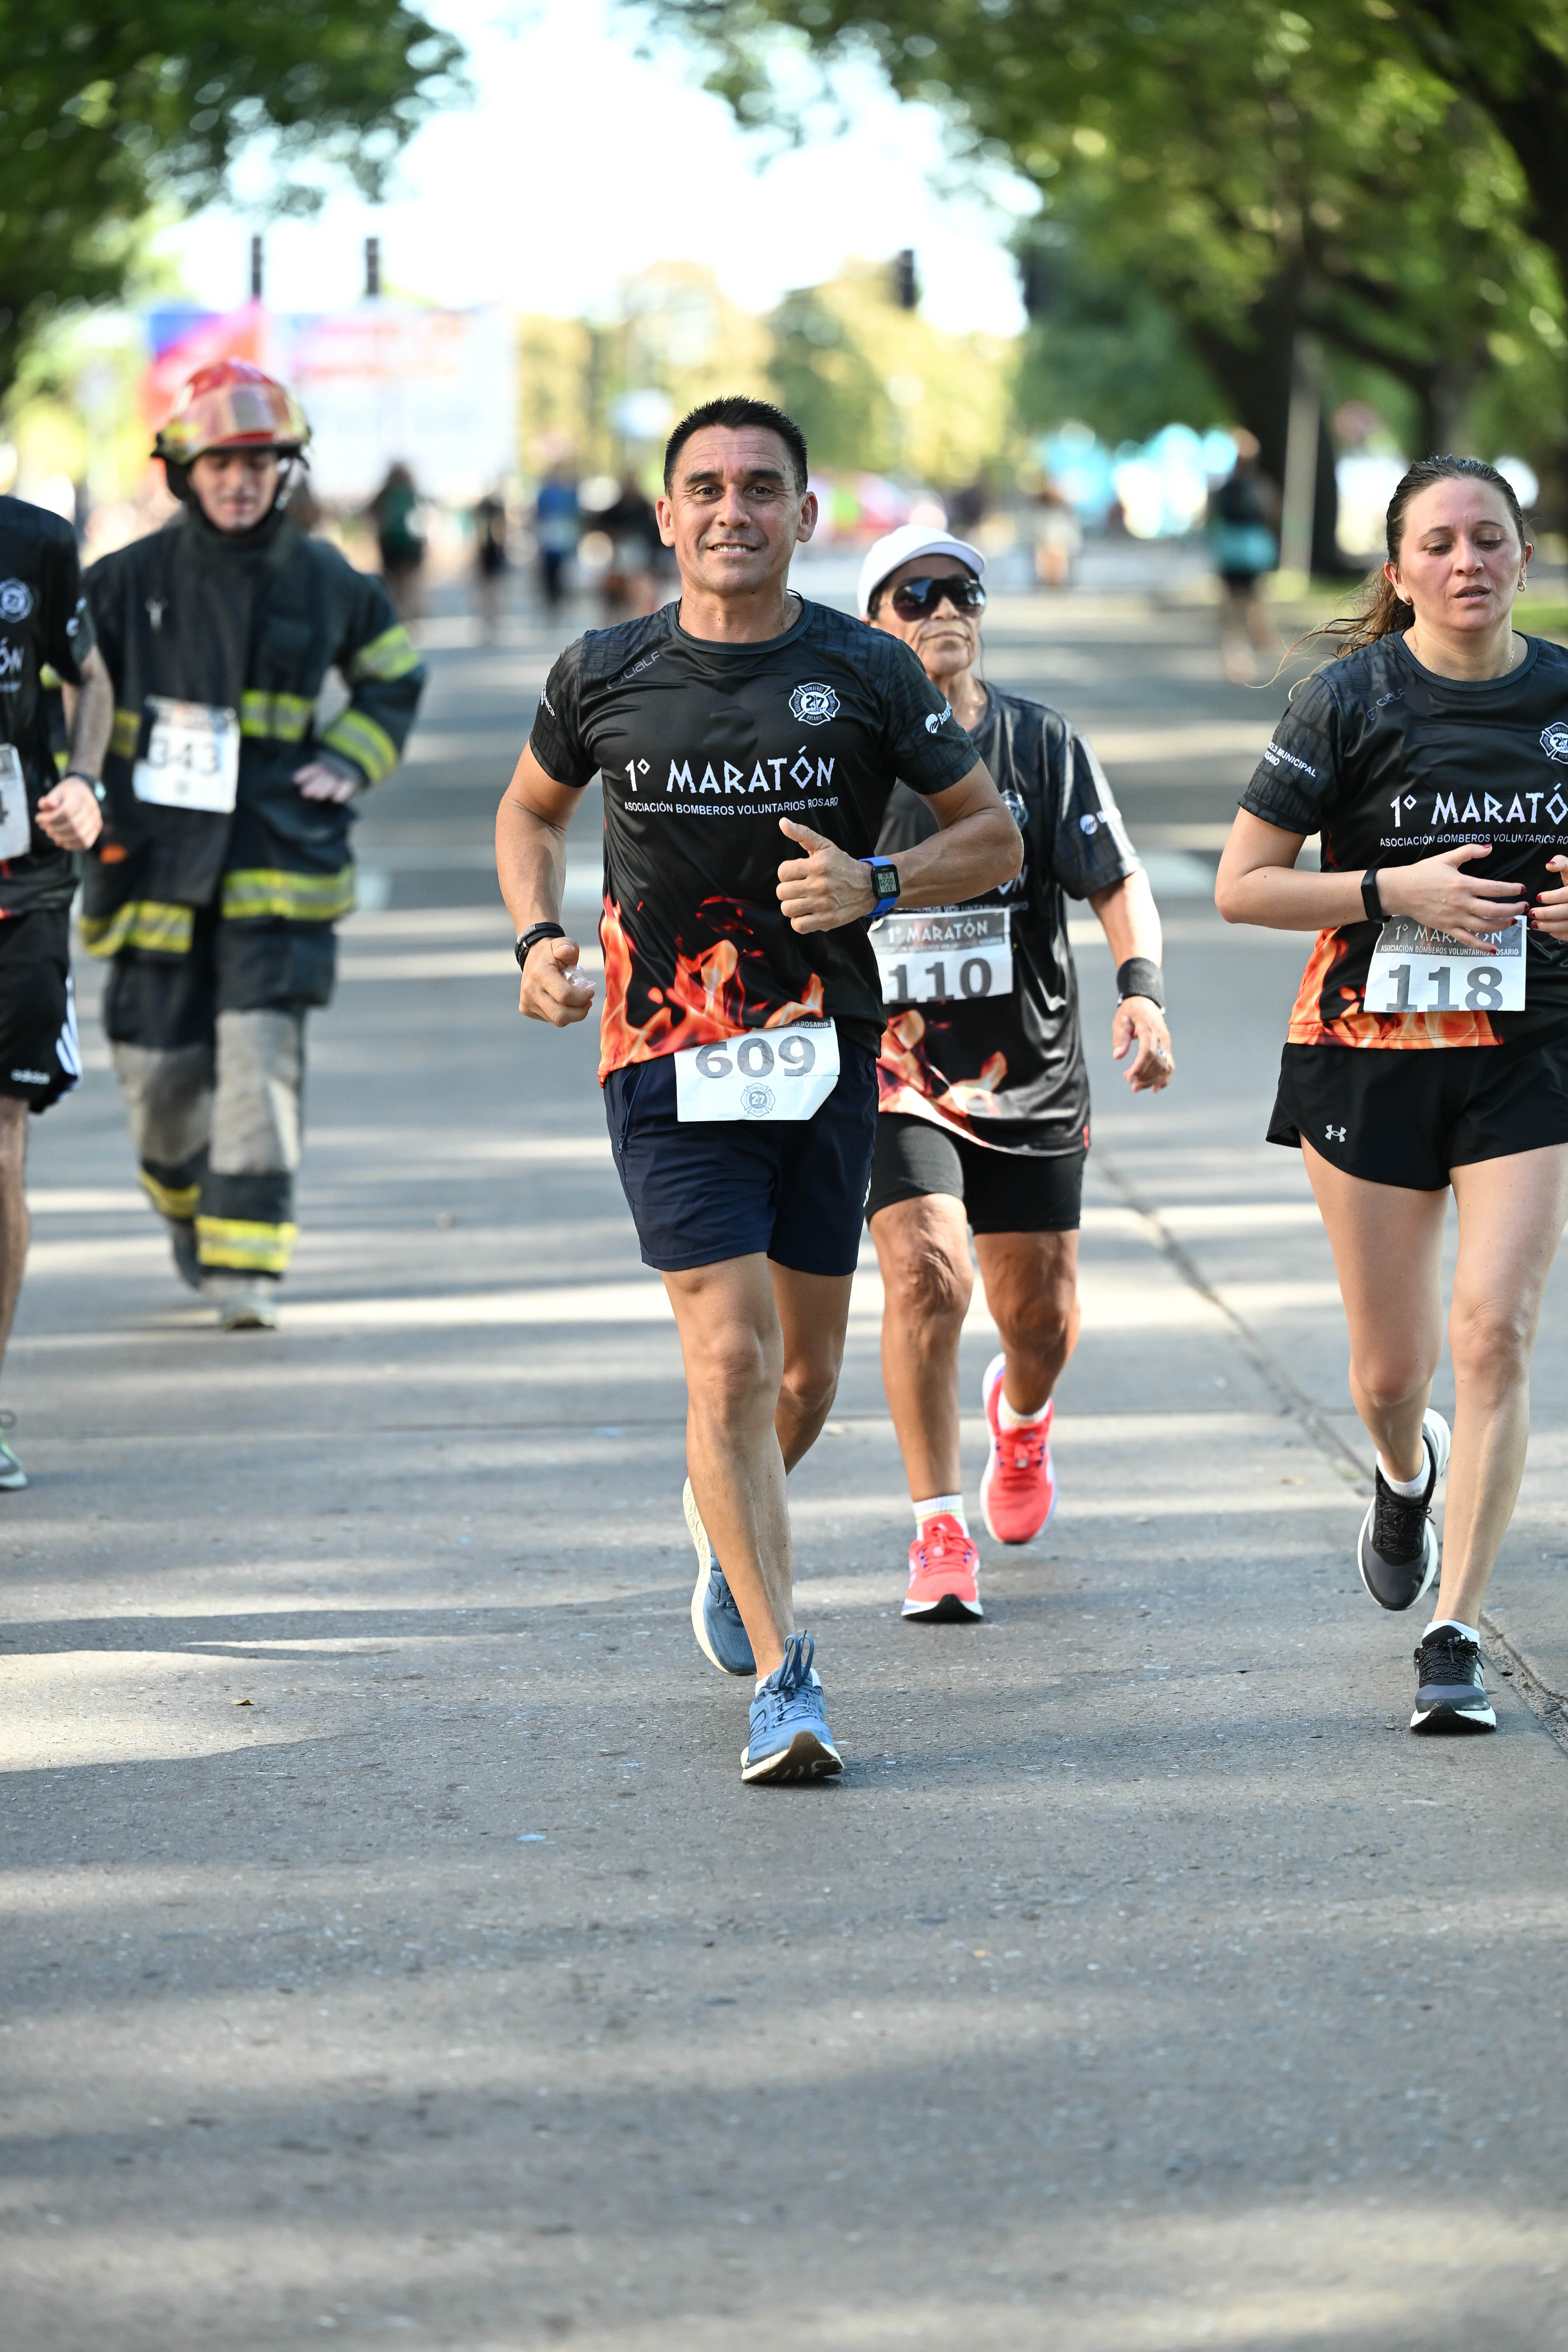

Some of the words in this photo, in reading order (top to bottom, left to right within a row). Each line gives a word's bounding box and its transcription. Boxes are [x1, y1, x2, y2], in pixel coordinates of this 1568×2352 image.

[806, 695, 824, 709] 27
[625, 758, 650, 791] 1°
[667, 745, 835, 794] MARATÓN
[1276, 748, 1316, 777] MUNICIPAL
[625, 801, 674, 812] ASOCIACIÓN
[676, 804, 735, 815] BOMBEROS
[737, 800, 805, 815] VOLUNTARIOS
[1390, 794, 1417, 827] 1°
[1380, 834, 1435, 847] ASOCIACIÓN
[1437, 834, 1490, 843] BOMBEROS
[1494, 834, 1555, 844] VOLUNTARIOS
[906, 917, 989, 942] MARATÓN
[1396, 923, 1408, 940] 1°
[1381, 943, 1413, 952] ASOCIACIÓN
[1415, 946, 1447, 955] BOMBEROS
[889, 958, 992, 1004] 110
[1386, 964, 1503, 1012] 118
[695, 1035, 816, 1078] 609
[752, 1093, 765, 1105] 27
